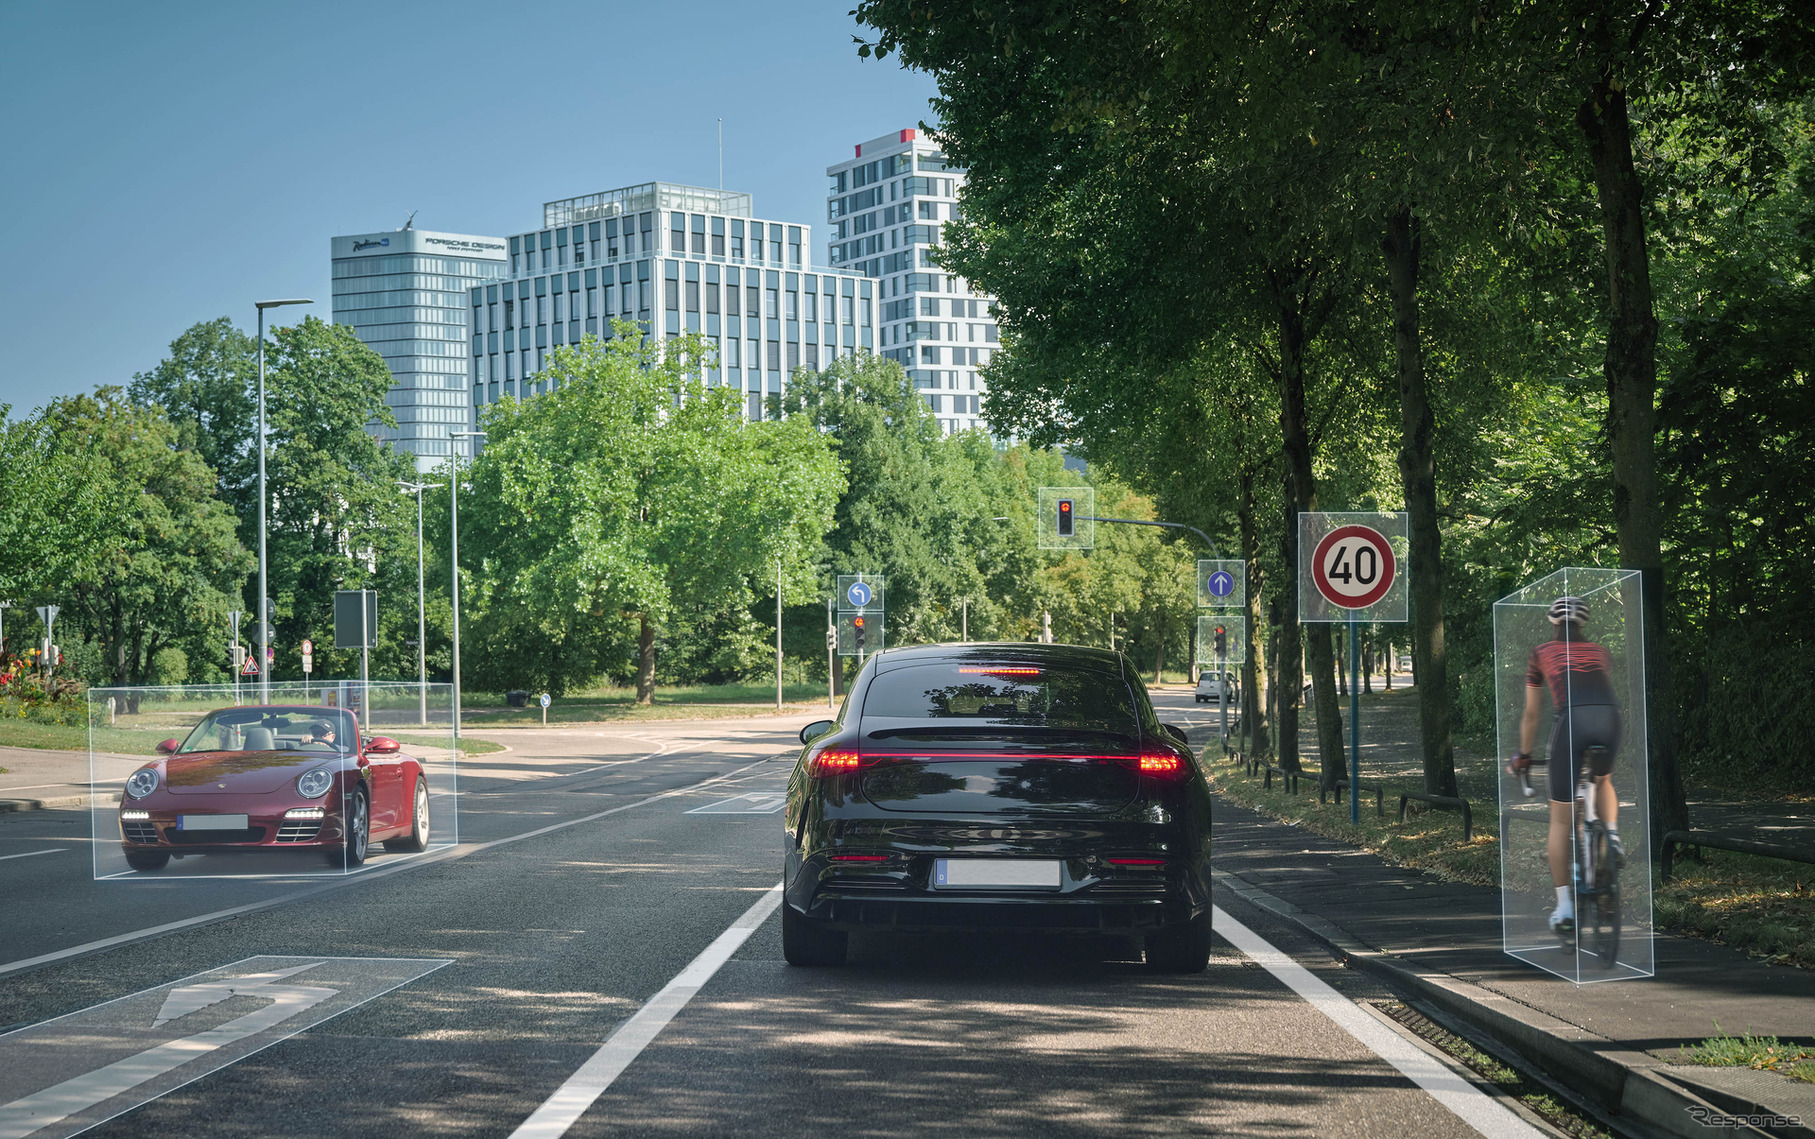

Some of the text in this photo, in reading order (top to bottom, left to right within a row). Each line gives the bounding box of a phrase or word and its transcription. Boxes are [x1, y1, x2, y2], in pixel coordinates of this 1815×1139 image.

[425, 238, 469, 247] PORSCHE
[472, 242, 505, 250] DESIGN
[1329, 546, 1376, 585] 40
